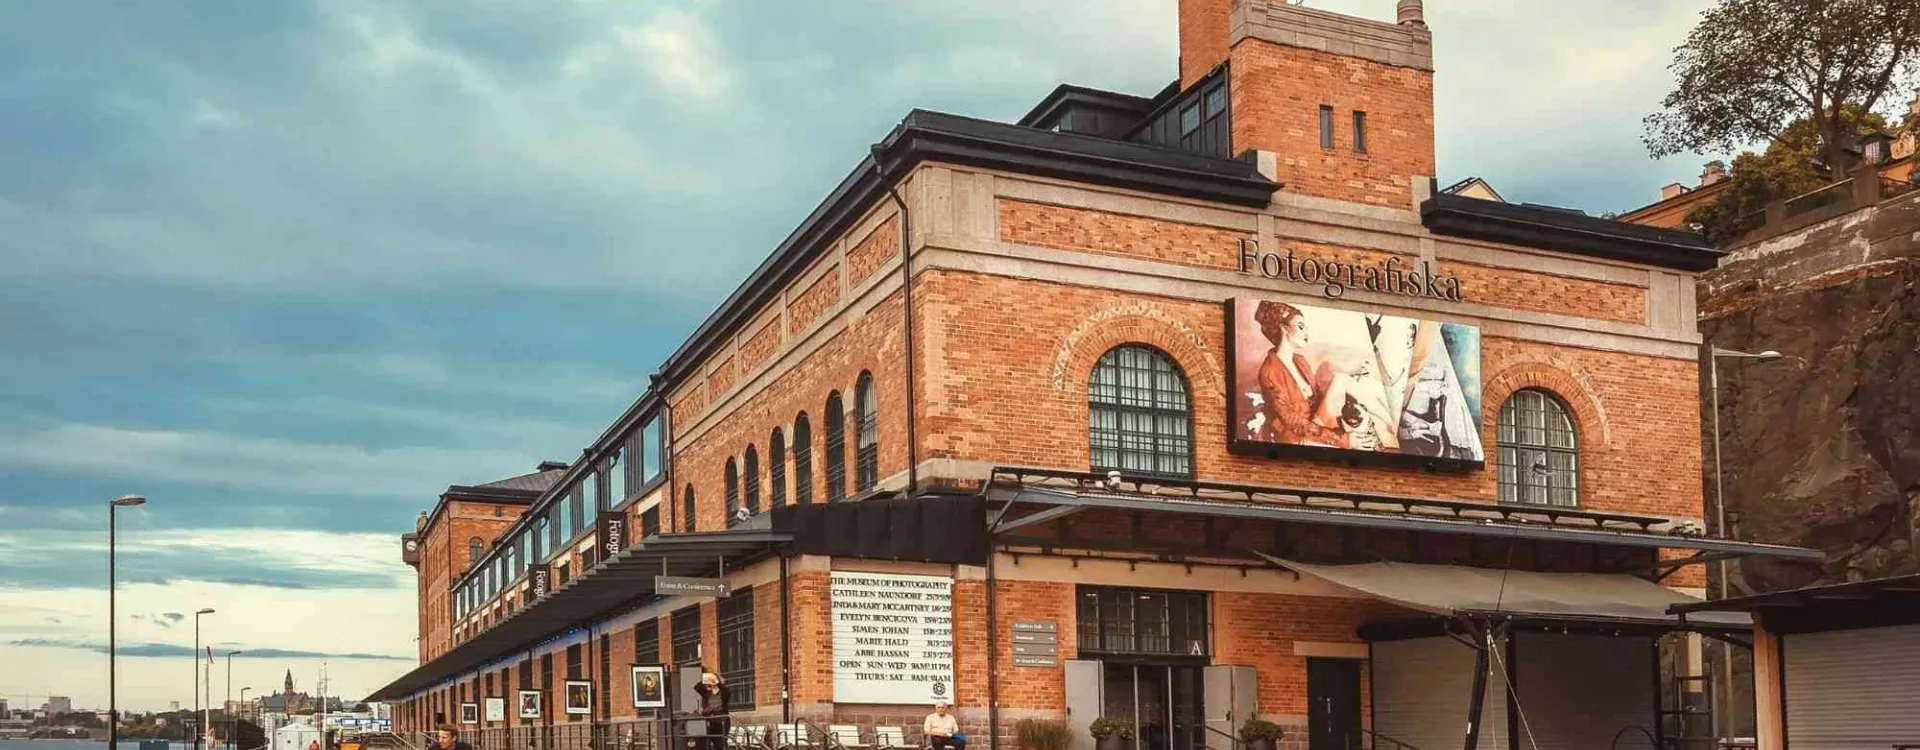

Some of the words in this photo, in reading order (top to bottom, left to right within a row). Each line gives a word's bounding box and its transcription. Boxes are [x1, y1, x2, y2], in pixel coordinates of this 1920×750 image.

[1236, 238, 1463, 302] Fotografiska
[846, 578, 880, 586] MUSEUM
[880, 579, 891, 587] OF
[892, 580, 949, 589] PHOTOGRAPHY
[832, 589, 876, 597] CATHLEEN
[878, 591, 922, 600] NAUNDORF
[840, 613, 871, 621] EVELYN
[852, 625, 879, 633] SIMEN
[881, 626, 910, 635] JOHAN
[855, 637, 884, 645] MARIE
[884, 638, 909, 646] HALD
[1190, 639, 1203, 656] A
[877, 650, 910, 658] HASSAN
[839, 660, 861, 669] OPEN
